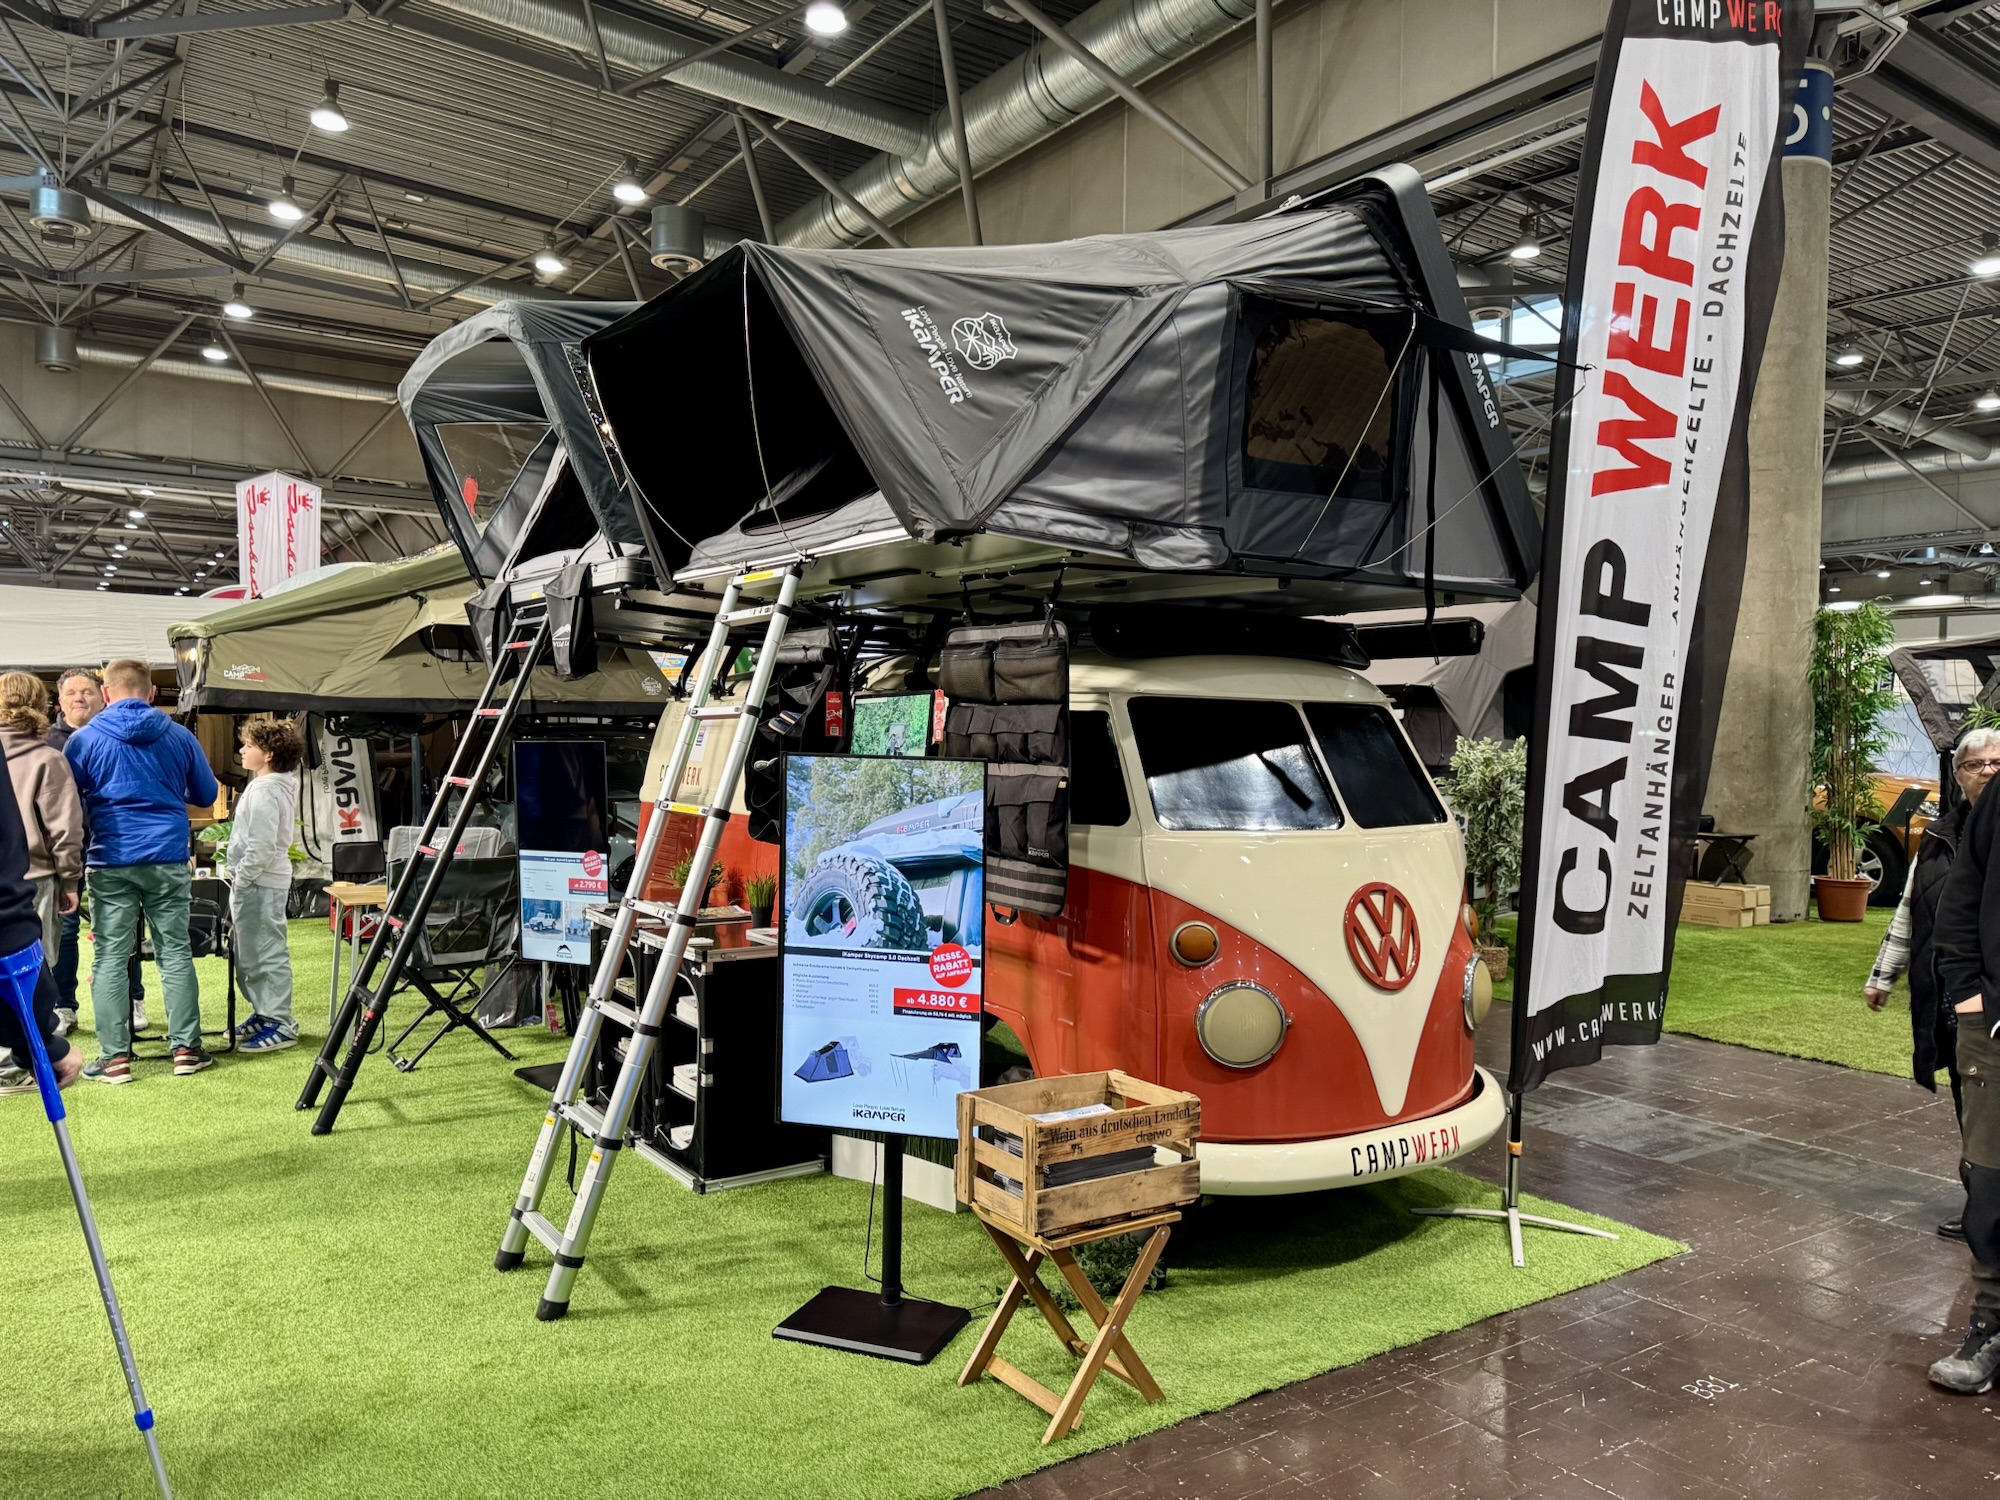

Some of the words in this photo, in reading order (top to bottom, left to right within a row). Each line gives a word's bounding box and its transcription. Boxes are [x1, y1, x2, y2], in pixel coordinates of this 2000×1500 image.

[1591, 78, 1722, 496] WERK
[1627, 672, 1675, 919] ZELTANHÄNGER
[1702, 131, 1748, 317] DACHZELTE
[1552, 538, 1651, 935] CAMP
[933, 950, 965, 962] MESSE-
[933, 959, 969, 972] RABATT
[917, 993, 955, 1007] 4.880
[959, 996, 968, 1008] €
[1050, 1127, 1076, 1144] Wein
[1079, 1124, 1098, 1139] aus
[1101, 1113, 1151, 1134] deutschen
[1351, 1124, 1460, 1177] CAMPWERK
